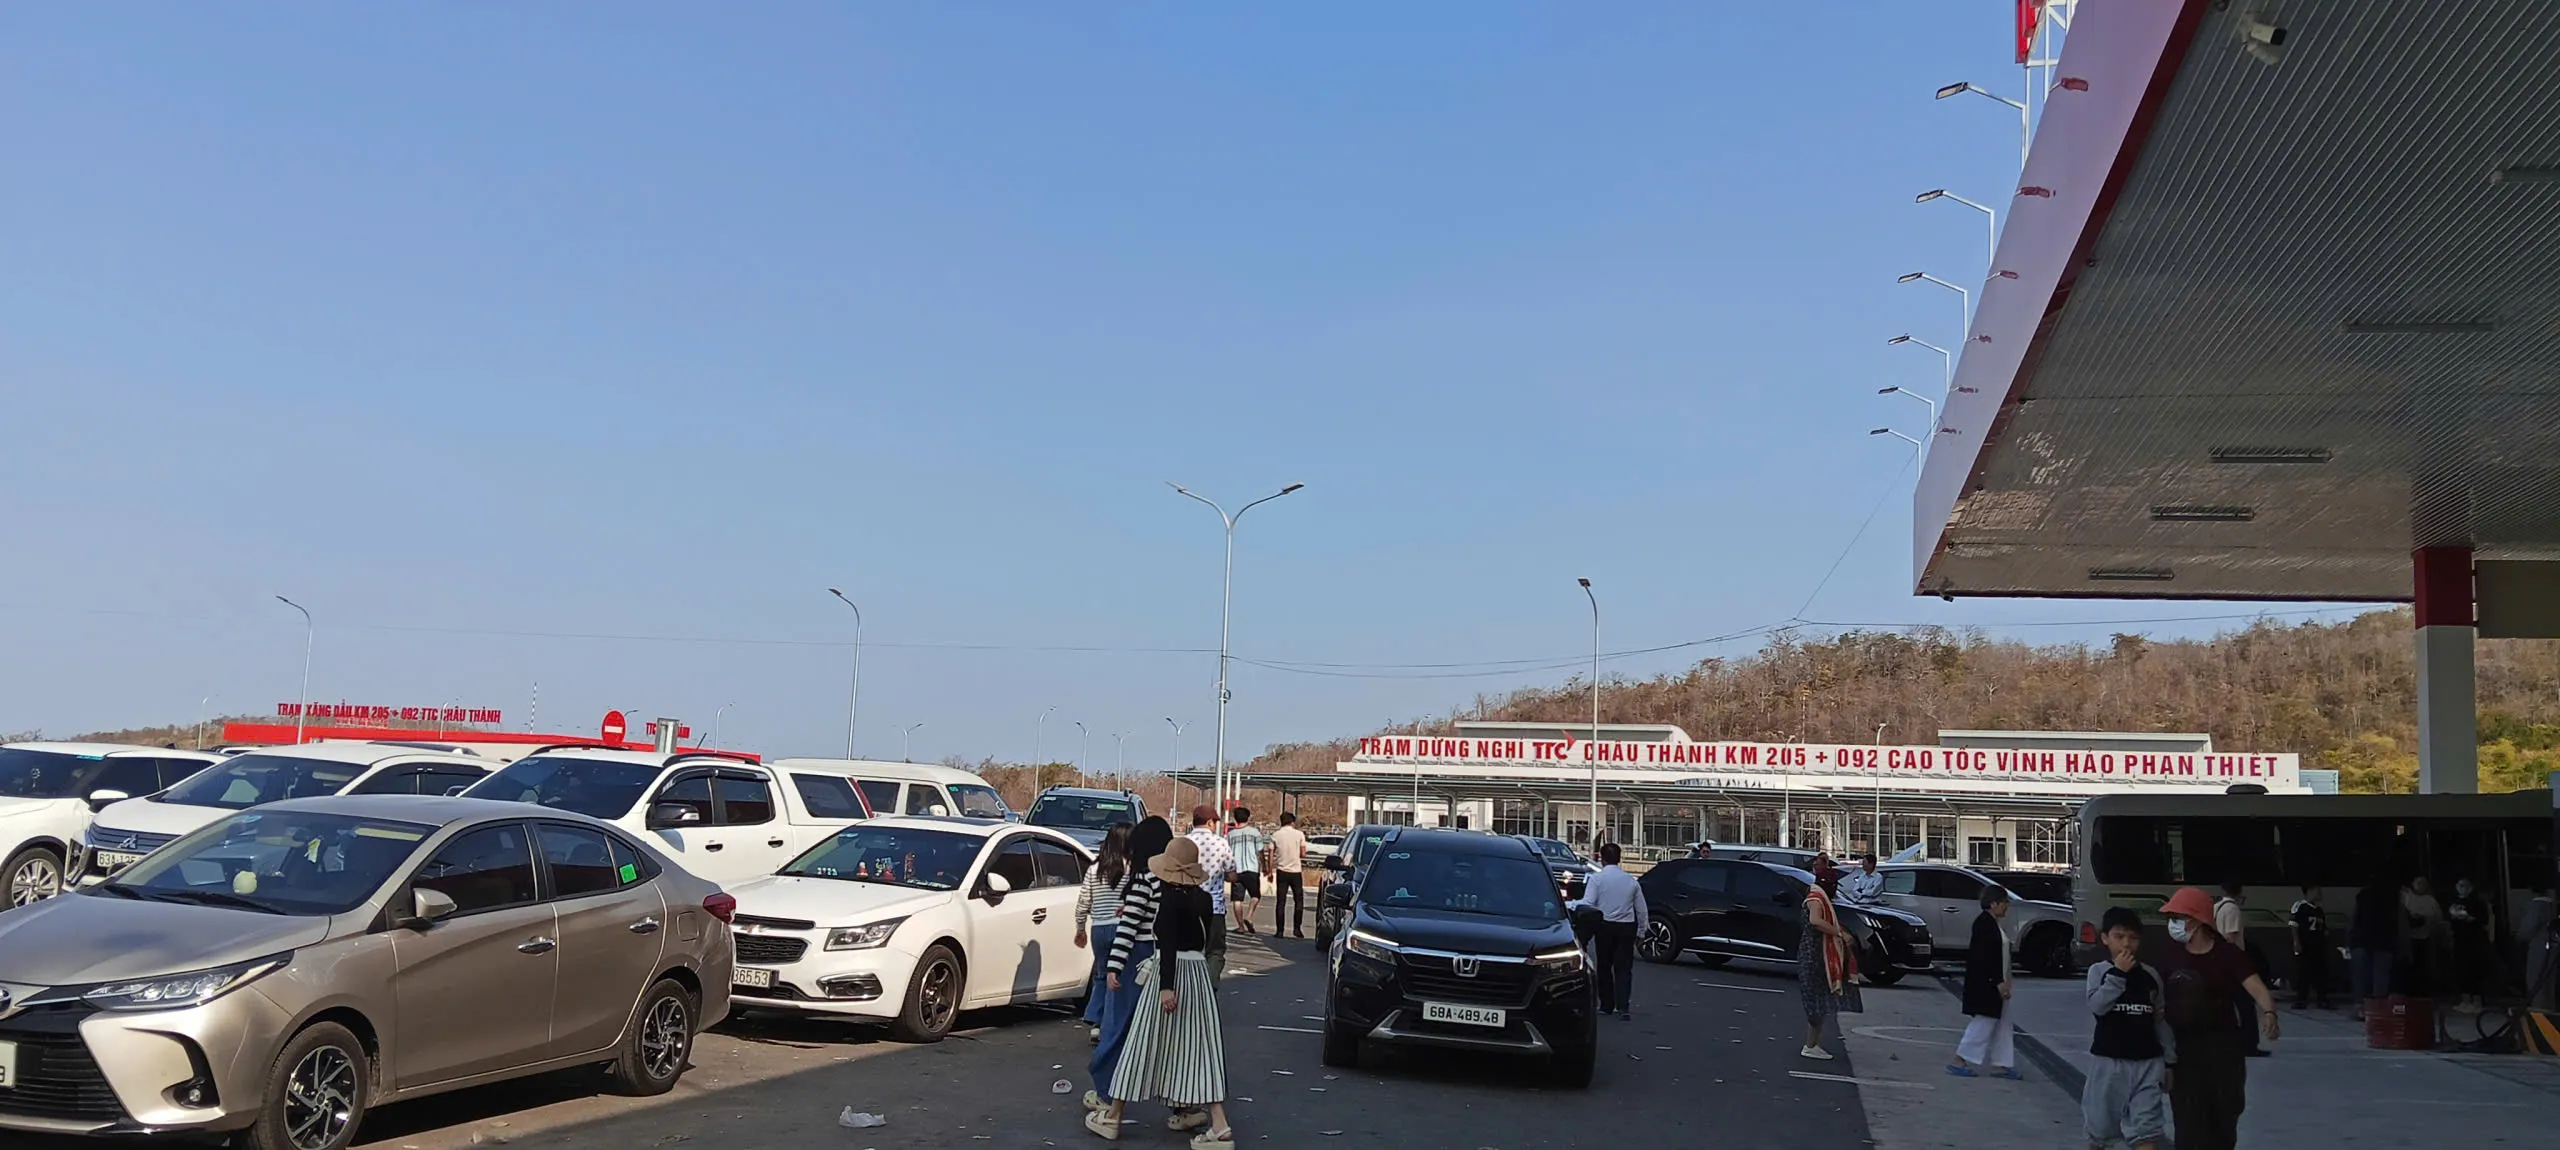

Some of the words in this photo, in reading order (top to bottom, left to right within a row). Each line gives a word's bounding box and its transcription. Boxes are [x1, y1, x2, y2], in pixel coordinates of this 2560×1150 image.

[372, 706, 390, 719] 205
[401, 708, 419, 720] 092
[422, 708, 438, 720] TTC
[1360, 737, 1411, 760] TRẠM
[1418, 736, 1469, 758] DỪNG
[1533, 742, 1569, 760] TTC
[1584, 739, 1638, 762] CHÂU
[1647, 740, 1716, 764] THÀNH
[1725, 745, 1758, 765] KM
[1766, 747, 1806, 767] 205
[1815, 752, 1828, 764] +
[1837, 749, 1878, 769] 092
[1888, 749, 1933, 769] CAO
[1942, 745, 1986, 771] TỐC
[2066, 746, 2114, 774] HẢO
[2125, 755, 2193, 776] PHAN
[1430, 1006, 1499, 1023] 68A-489.48
